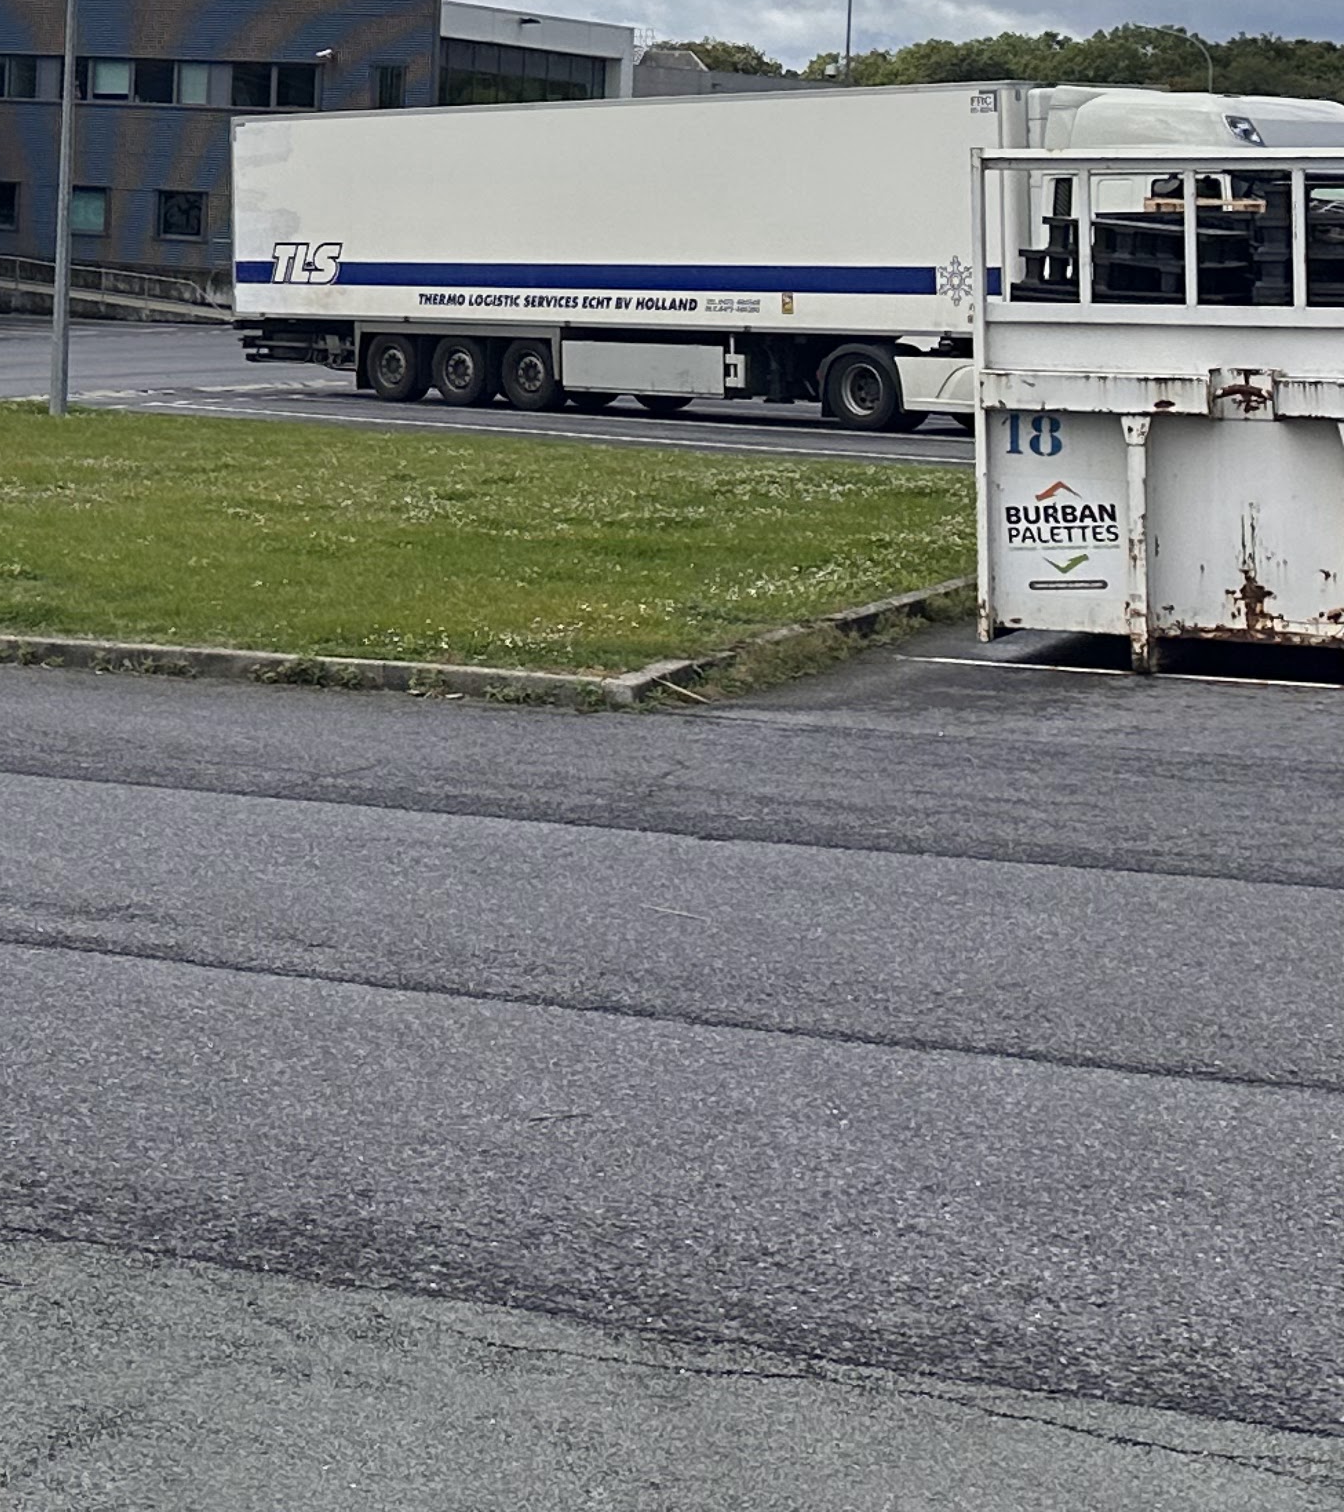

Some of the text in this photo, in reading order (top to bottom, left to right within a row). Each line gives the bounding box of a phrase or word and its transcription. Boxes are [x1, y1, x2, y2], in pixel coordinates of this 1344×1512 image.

[272, 242, 344, 285] TLS
[419, 293, 466, 306] THERMO
[468, 294, 520, 307] LOGISTIC
[523, 295, 579, 309] SERVICES
[582, 296, 612, 309] ECHT
[614, 296, 633, 310] BV
[635, 297, 698, 311] HOLLAND
[1002, 414, 1063, 457] 18
[1005, 504, 1117, 524] BURBAN
[1008, 524, 1119, 544] PALETTES
